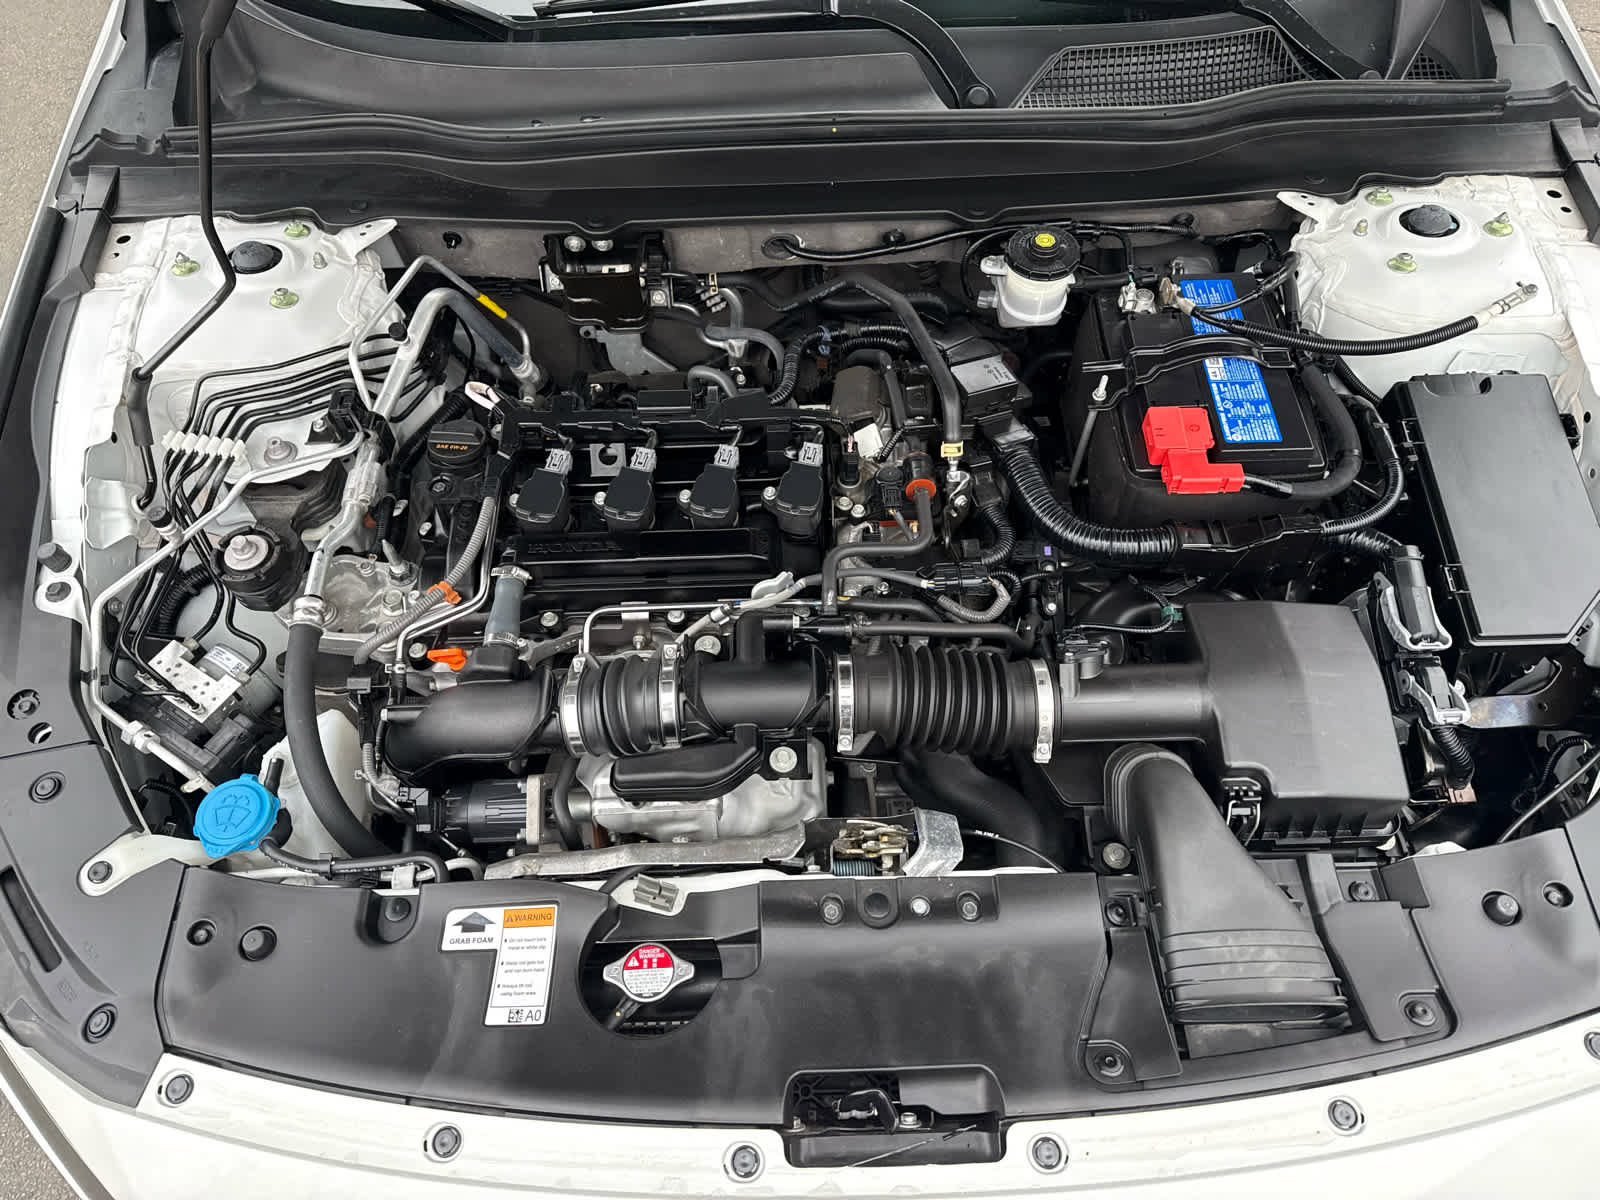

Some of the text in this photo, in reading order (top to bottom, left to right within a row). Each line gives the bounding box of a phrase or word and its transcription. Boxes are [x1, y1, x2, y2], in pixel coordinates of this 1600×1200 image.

[515, 912, 553, 922] WARNING
[449, 936, 494, 945] GRAB FOAM
[525, 1009, 542, 1022] A0
